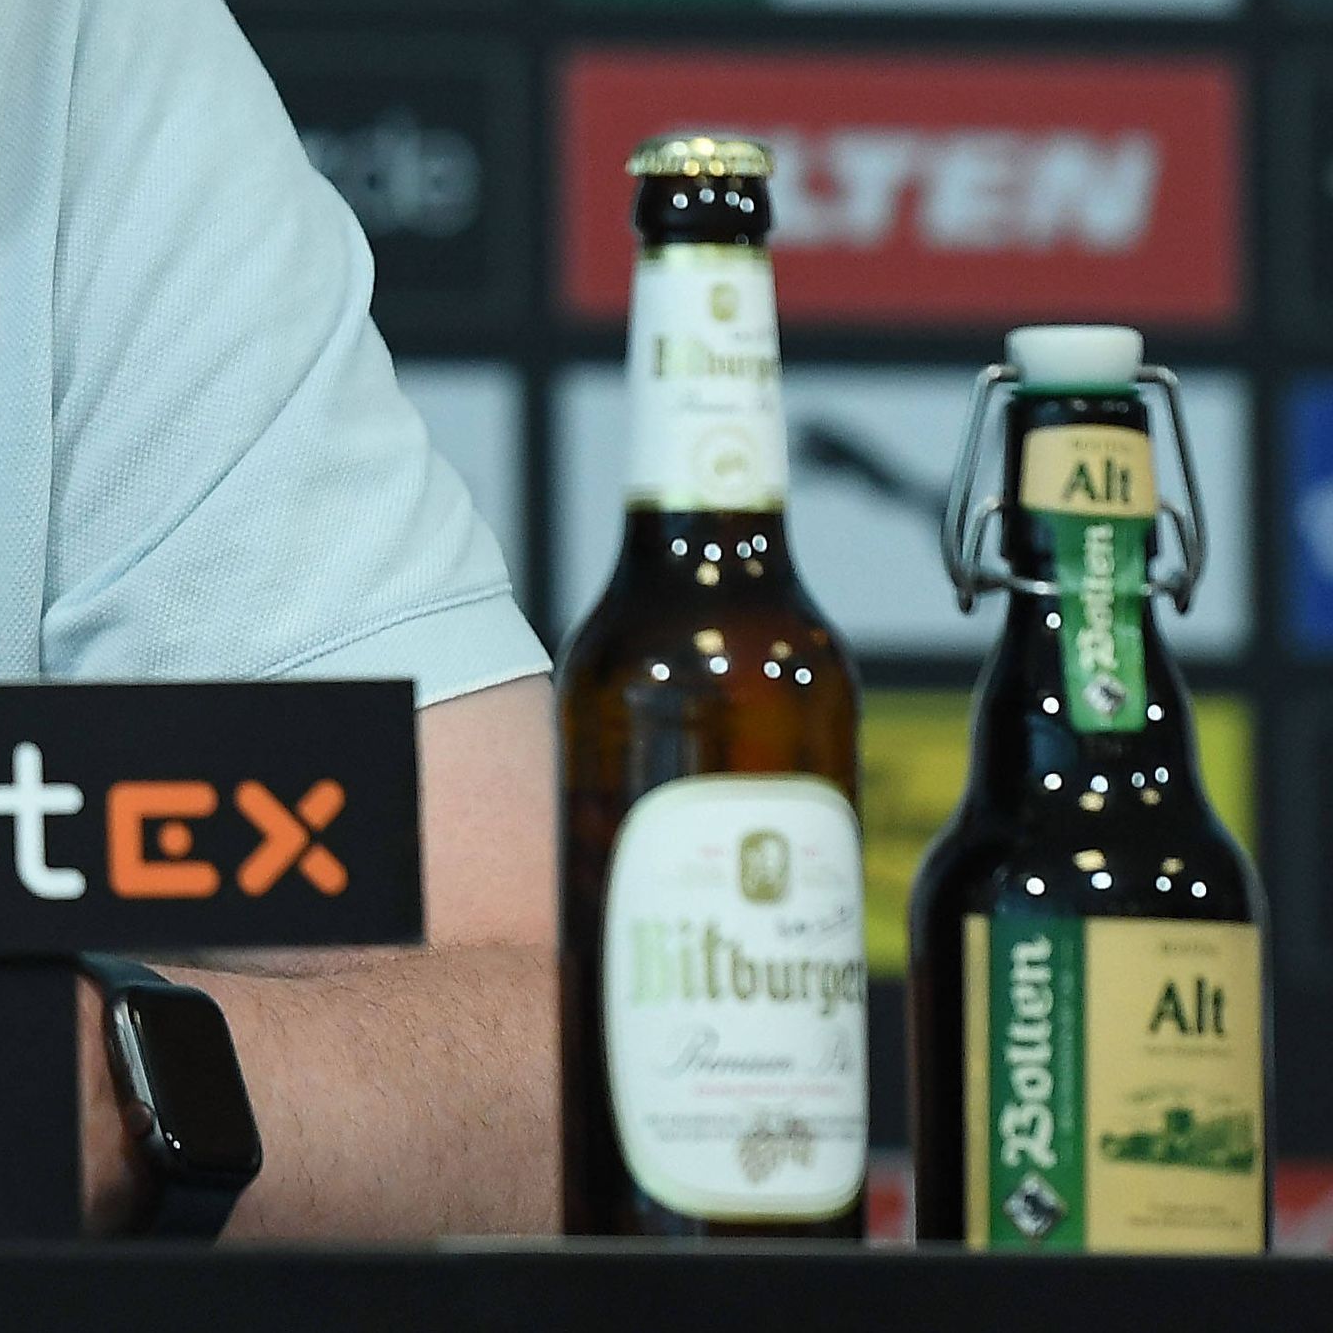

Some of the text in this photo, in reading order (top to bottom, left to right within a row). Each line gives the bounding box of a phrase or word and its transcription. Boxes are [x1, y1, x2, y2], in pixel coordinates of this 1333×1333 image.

[771, 127, 1161, 255] LTEN
[1062, 457, 1132, 505] Alt
[1147, 973, 1228, 1038] Alt
